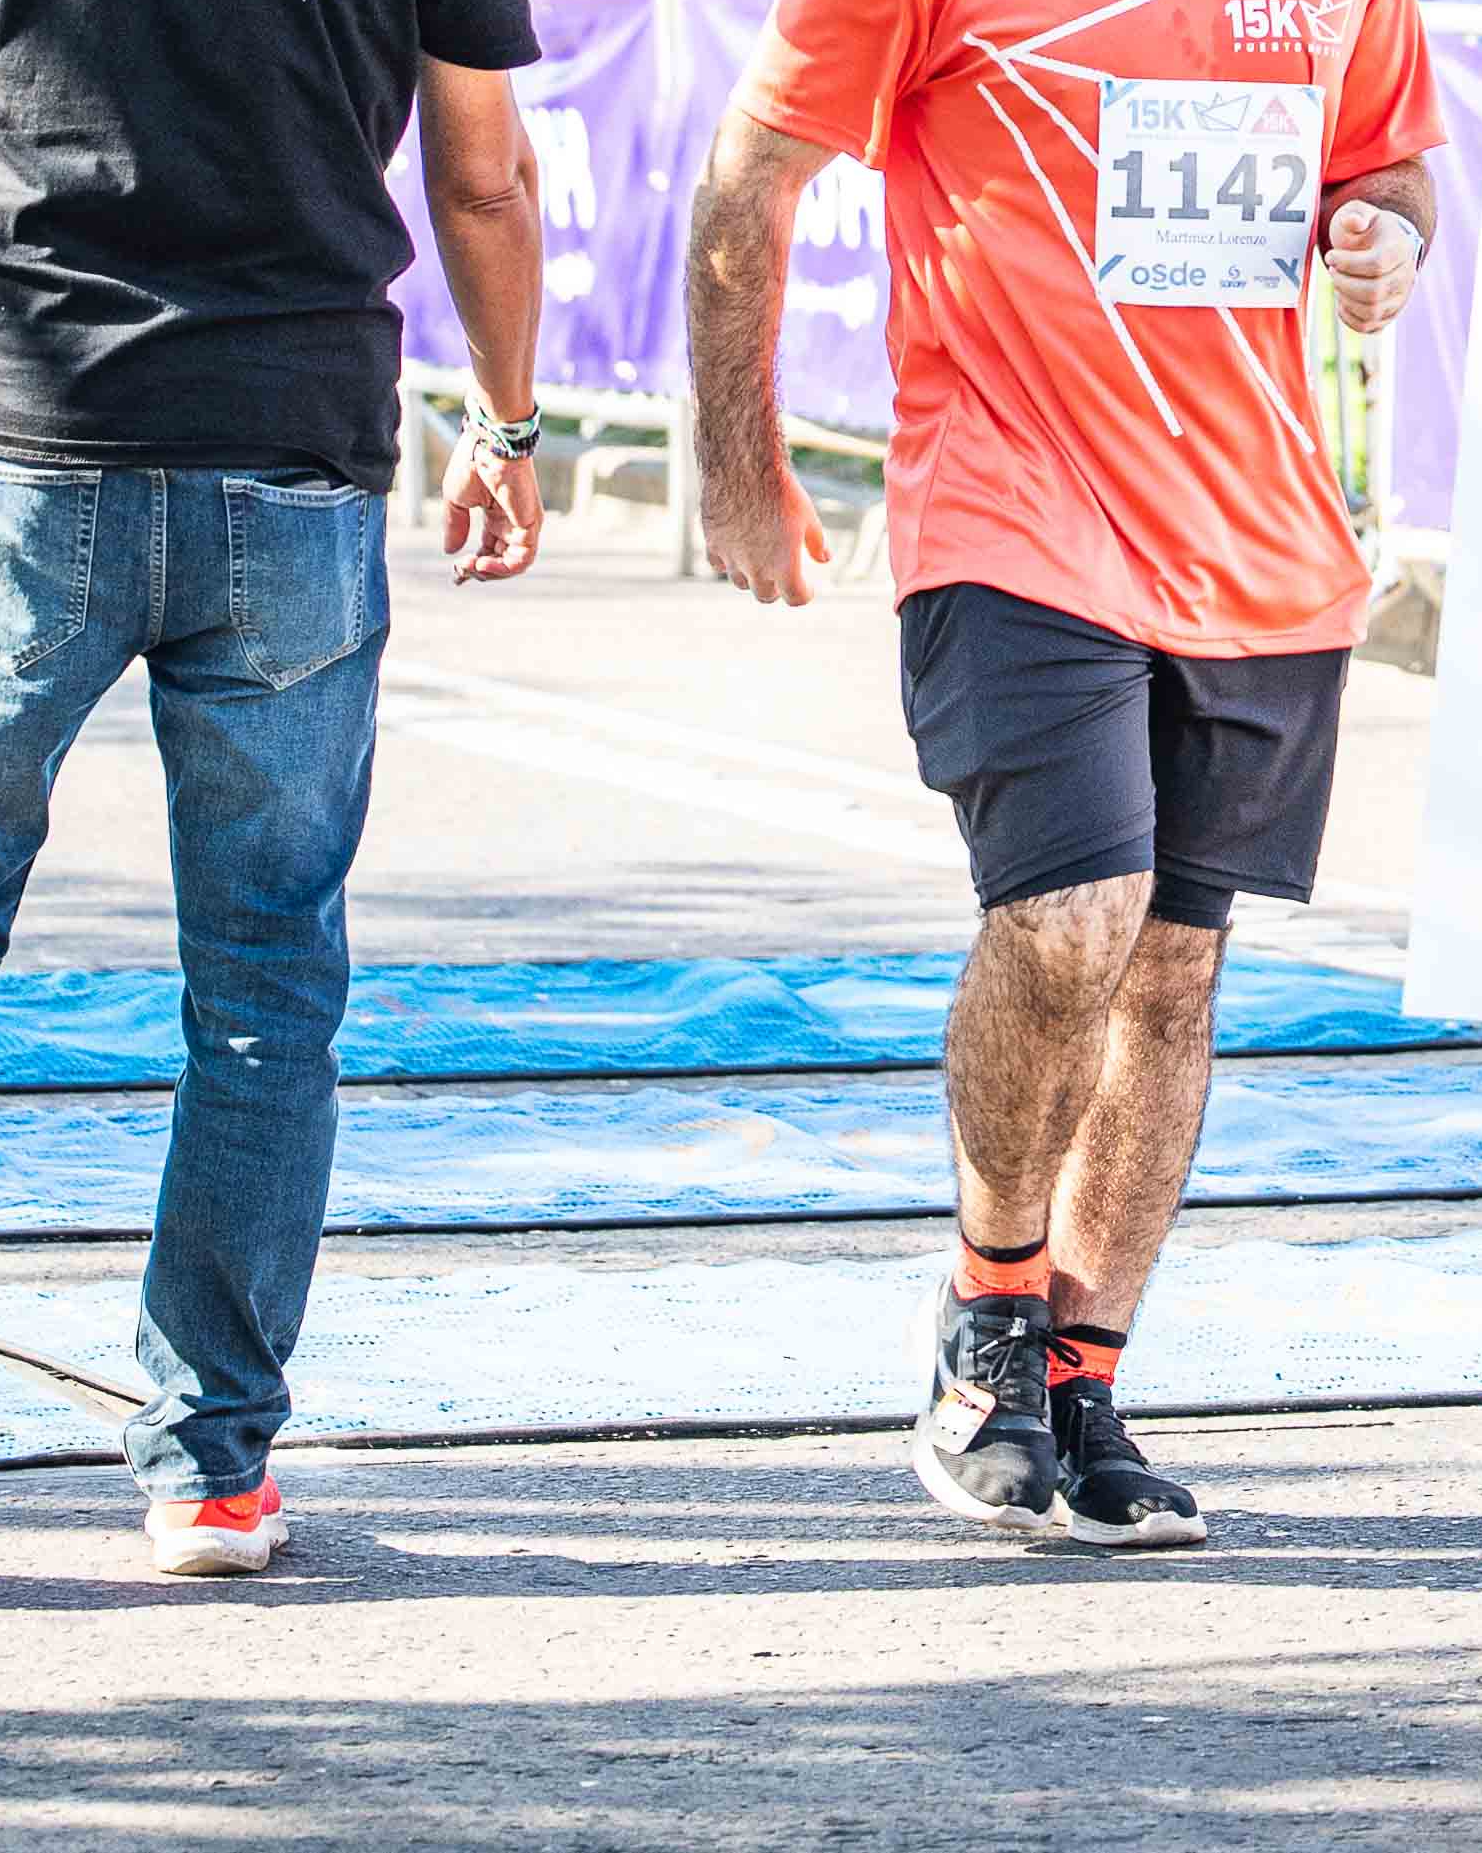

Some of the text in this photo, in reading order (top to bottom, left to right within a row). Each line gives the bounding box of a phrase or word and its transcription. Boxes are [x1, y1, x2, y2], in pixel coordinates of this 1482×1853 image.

[1126, 99, 1187, 131] 15K
[1111, 150, 1309, 223] 1142
[1131, 261, 1208, 291] osde
